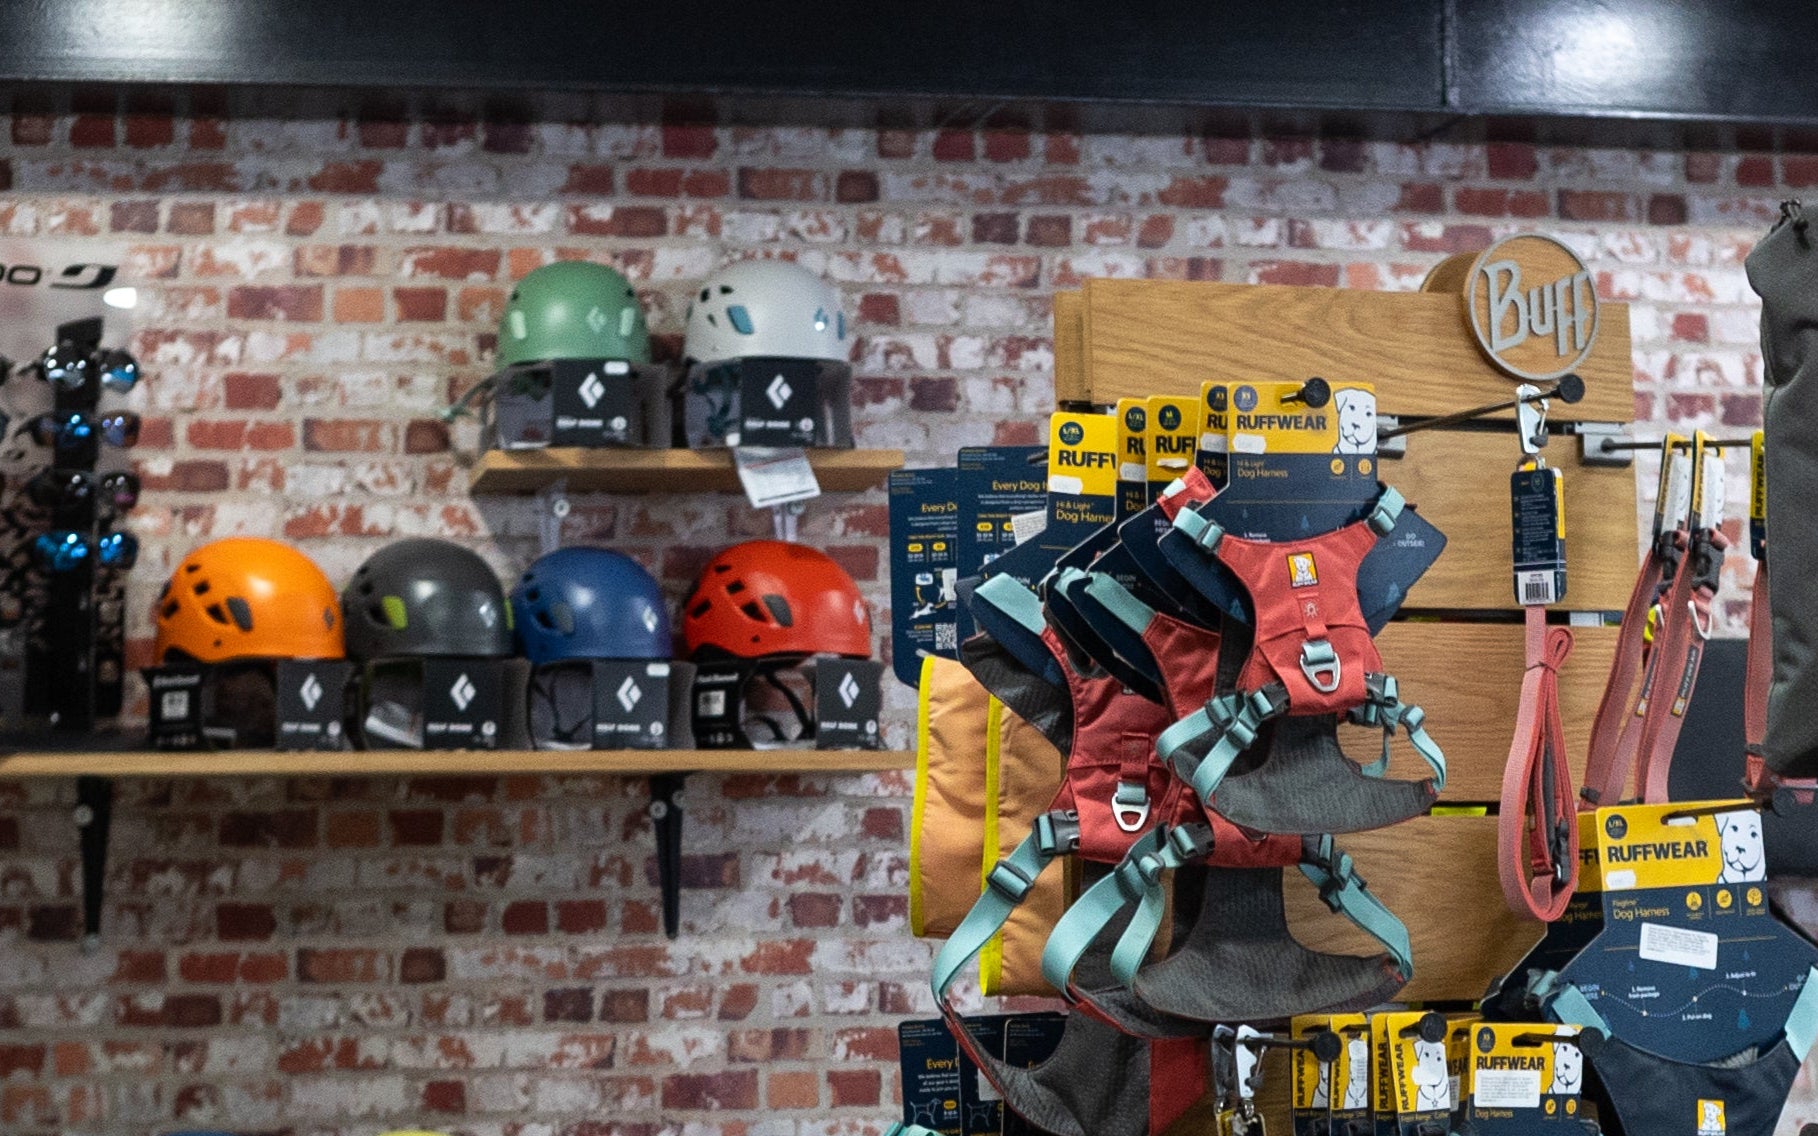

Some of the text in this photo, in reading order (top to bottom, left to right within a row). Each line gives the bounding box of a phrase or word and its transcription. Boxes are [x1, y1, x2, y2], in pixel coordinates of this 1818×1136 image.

[1236, 414, 1328, 431] RUFFWEAR
[1237, 468, 1255, 479] Dog
[992, 480, 1018, 492] Every
[1020, 480, 1040, 491] Dog
[921, 502, 946, 514] Every
[1056, 509, 1079, 523] Dog
[1606, 840, 1709, 864] RUFFWEAR
[1612, 908, 1634, 921] Dog
[1635, 906, 1671, 918] Harness
[926, 1057, 953, 1070] Every
[1476, 1055, 1546, 1070] RUFFWEAR
[1377, 1042, 1389, 1110] RUFFWEAR
[1394, 1043, 1410, 1111] RUFFWEAR
